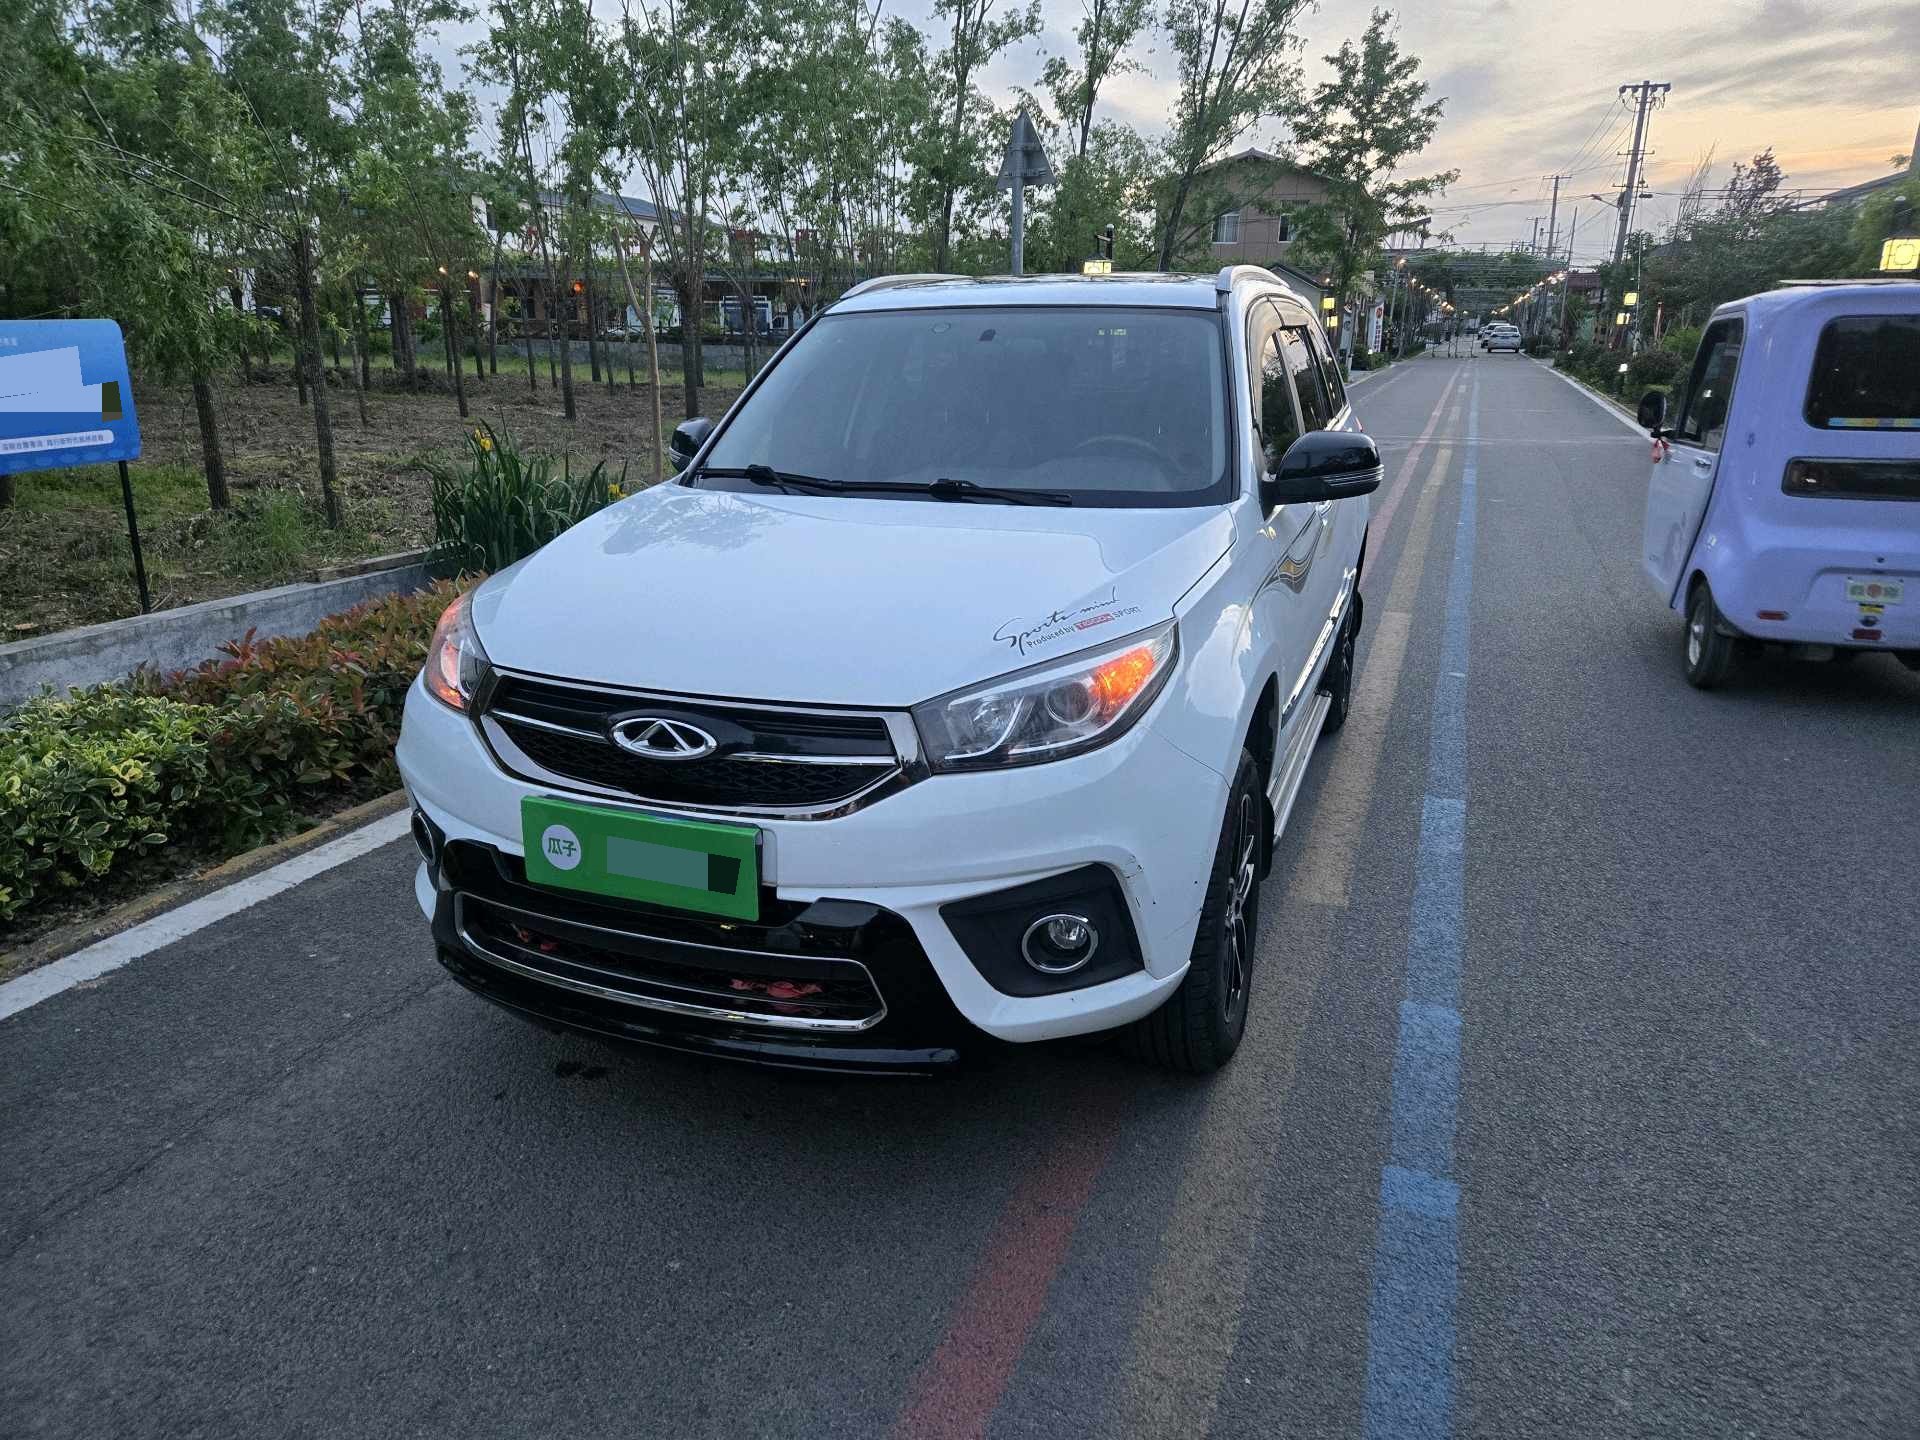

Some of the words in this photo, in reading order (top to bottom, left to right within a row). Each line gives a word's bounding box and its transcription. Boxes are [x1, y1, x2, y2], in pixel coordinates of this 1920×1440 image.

[1026, 628, 1065, 648] Produced
[1065, 624, 1075, 634] by
[547, 837, 577, 857] 瓜子
